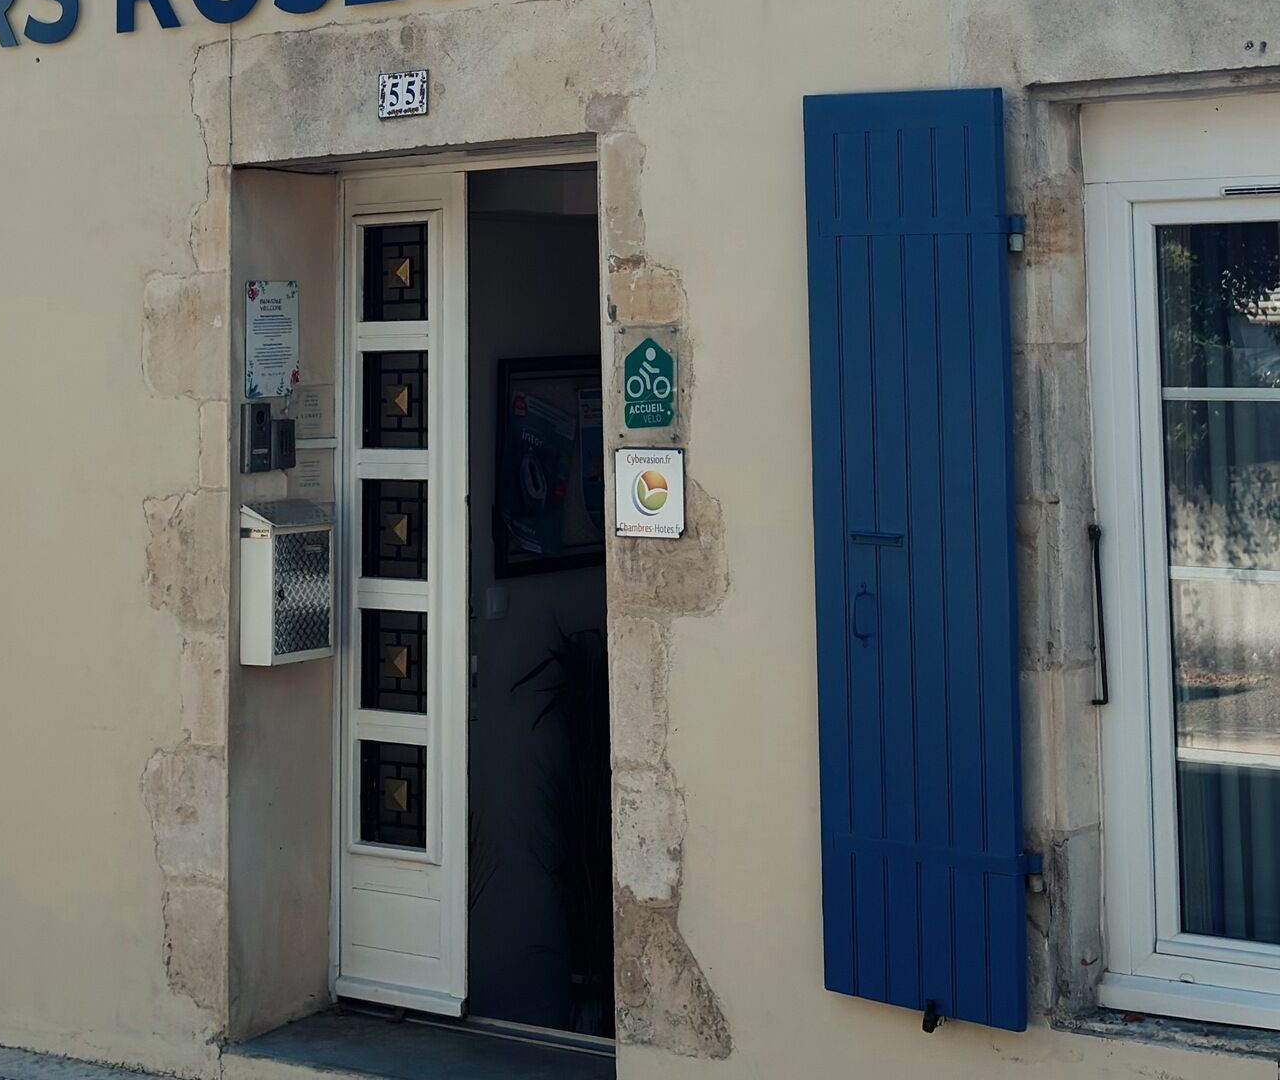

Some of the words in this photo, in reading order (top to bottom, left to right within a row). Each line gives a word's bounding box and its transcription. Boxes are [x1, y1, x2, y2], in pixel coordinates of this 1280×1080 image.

[389, 80, 416, 107] 55
[629, 403, 665, 415] ACCUEIL
[643, 414, 662, 424] VÉLO
[626, 454, 672, 466] Cybevasion.fr
